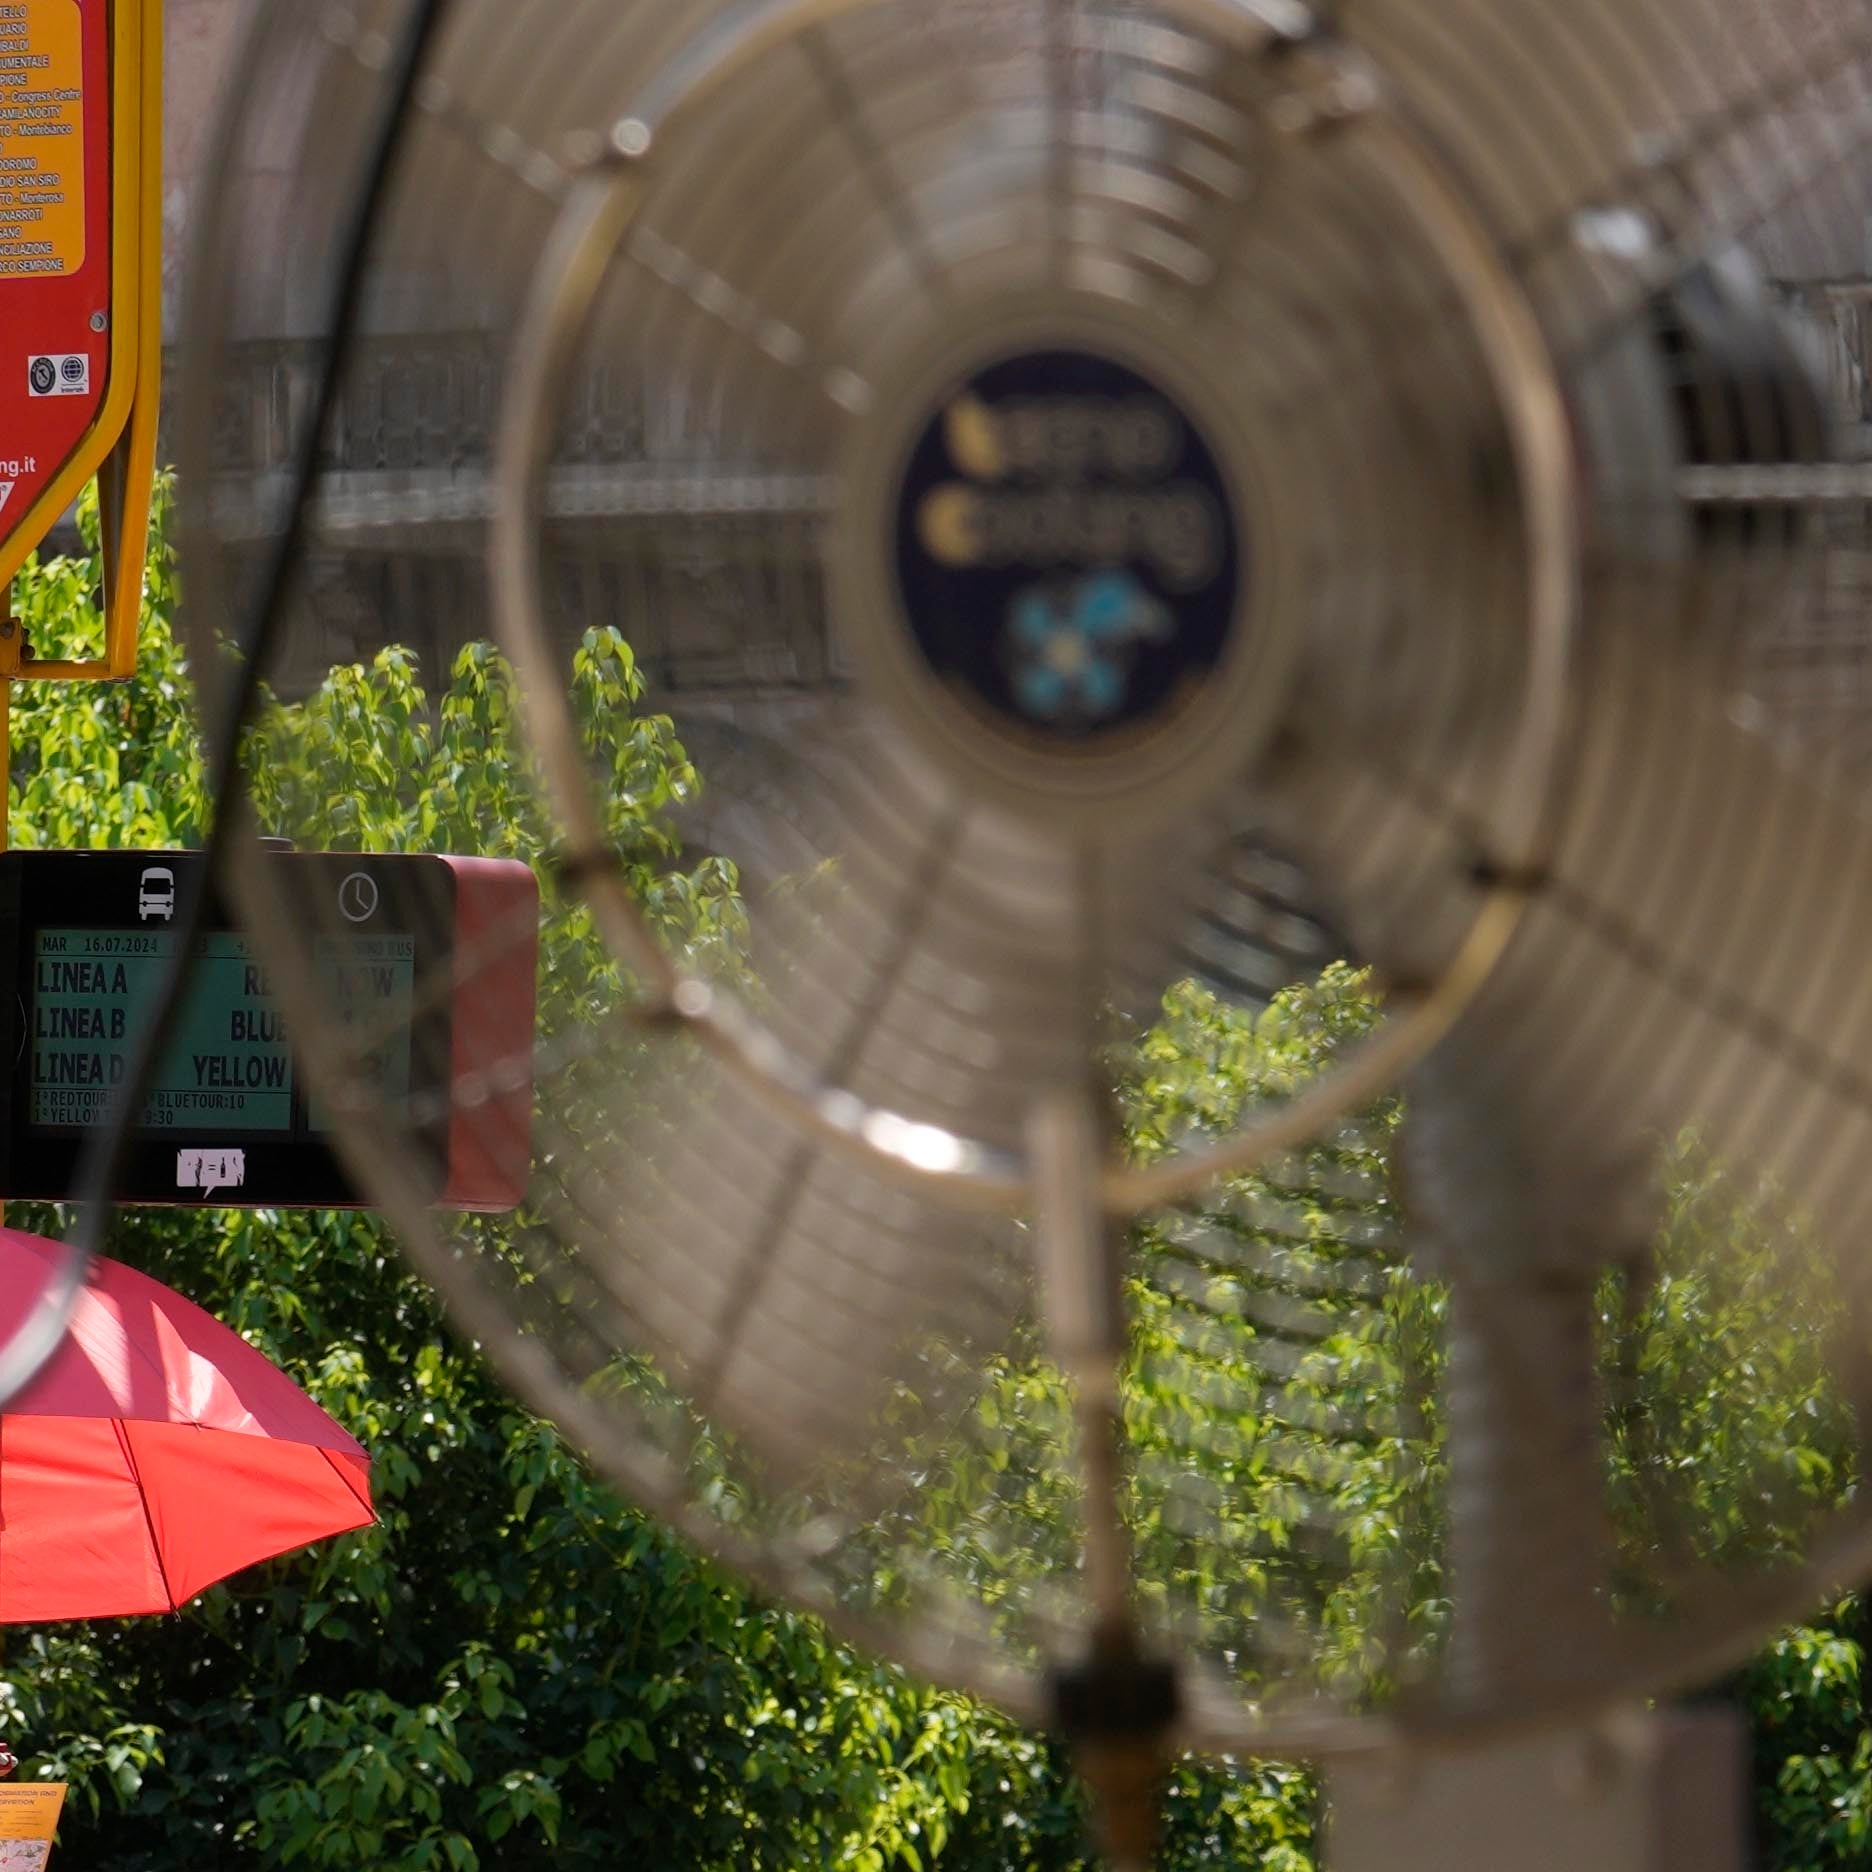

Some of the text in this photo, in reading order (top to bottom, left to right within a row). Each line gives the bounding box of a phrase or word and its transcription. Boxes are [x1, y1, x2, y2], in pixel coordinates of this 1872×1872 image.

[38, 174, 60, 185] SIRO
[43, 937, 67, 951] MAR
[38, 962, 107, 993] LINEA
[112, 964, 128, 994] A
[36, 1008, 106, 1039] LINEA
[111, 1008, 126, 1039] B
[35, 1054, 104, 1084] LINEA
[193, 1055, 287, 1088] YELLOW
